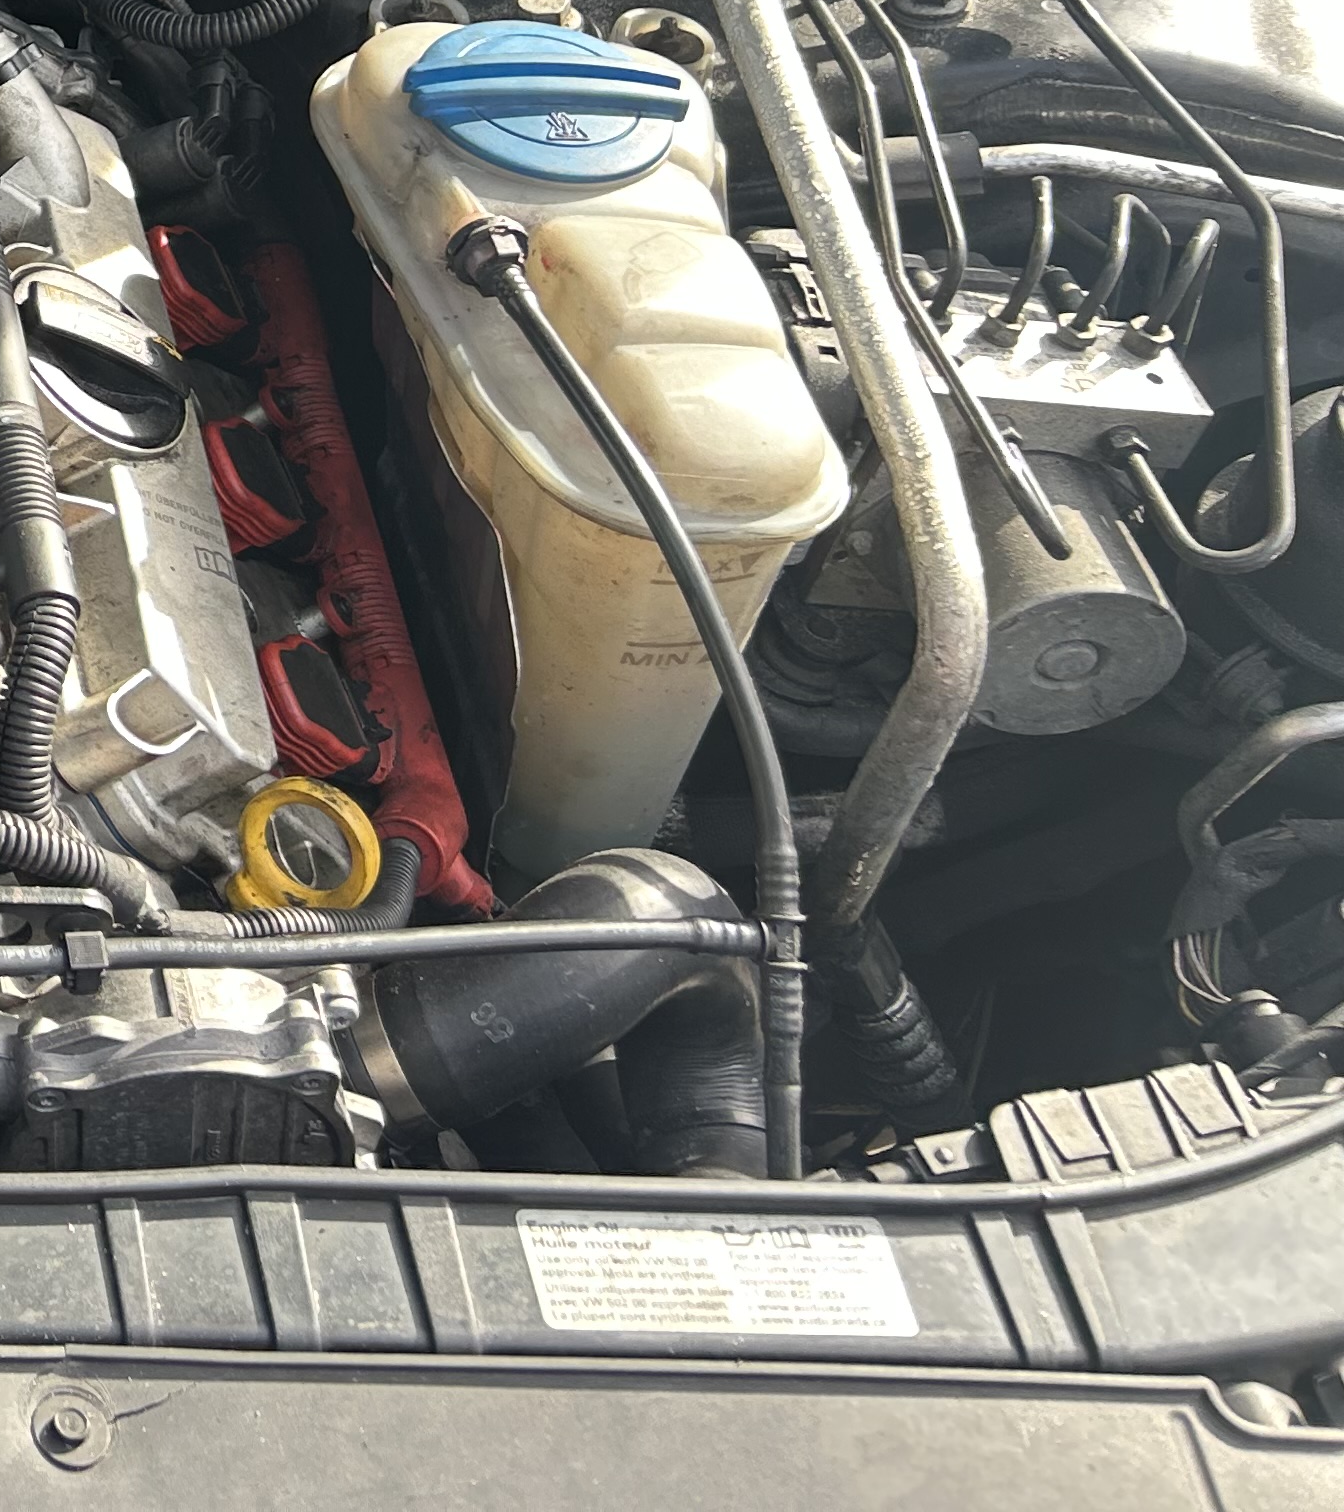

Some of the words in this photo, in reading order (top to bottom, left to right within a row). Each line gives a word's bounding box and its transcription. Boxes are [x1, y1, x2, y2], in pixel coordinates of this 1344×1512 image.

[619, 651, 690, 667] MIN
[531, 1237, 578, 1250] Huile
[584, 1239, 652, 1251] moteur
